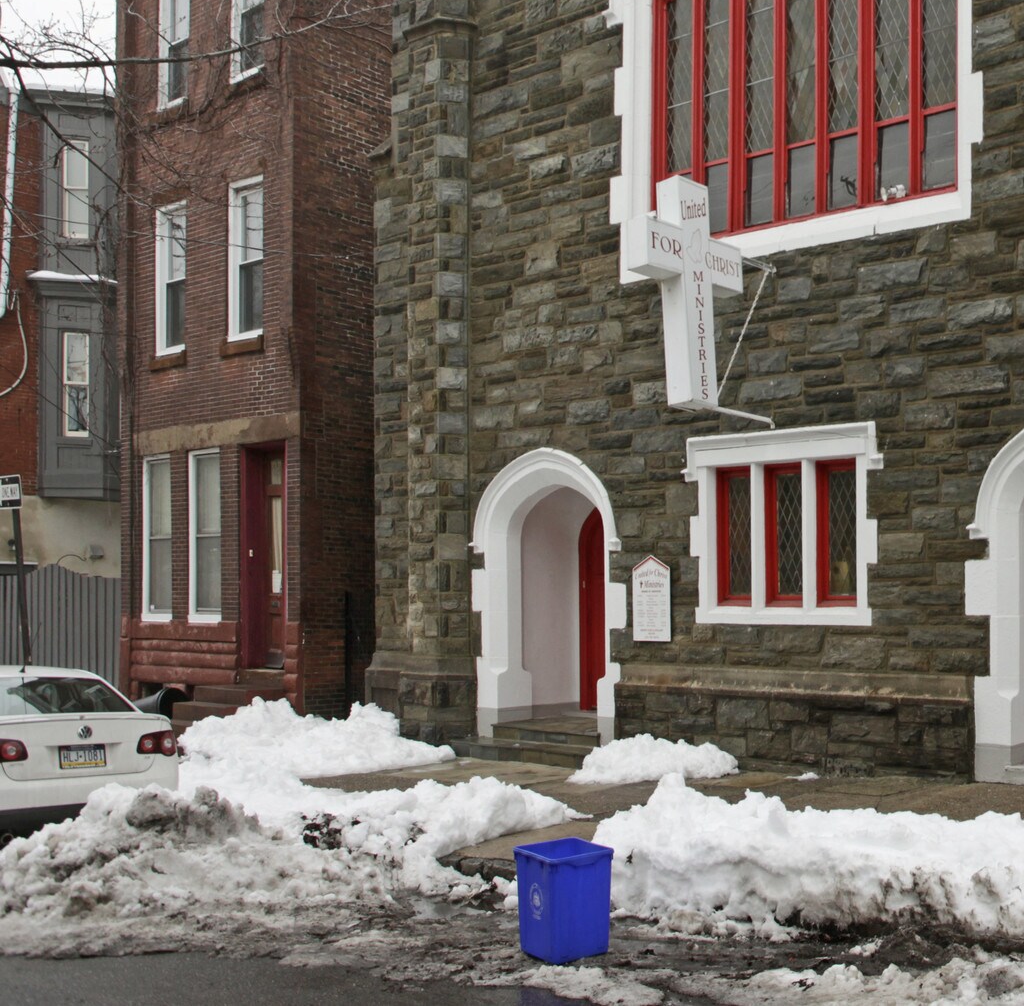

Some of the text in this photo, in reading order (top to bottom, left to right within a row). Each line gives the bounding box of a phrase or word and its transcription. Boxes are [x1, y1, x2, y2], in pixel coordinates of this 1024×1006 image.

[680, 197, 707, 221] United
[651, 230, 683, 260] FOR
[705, 251, 740, 278] CHRIST
[693, 270, 709, 401] MINISTRIES
